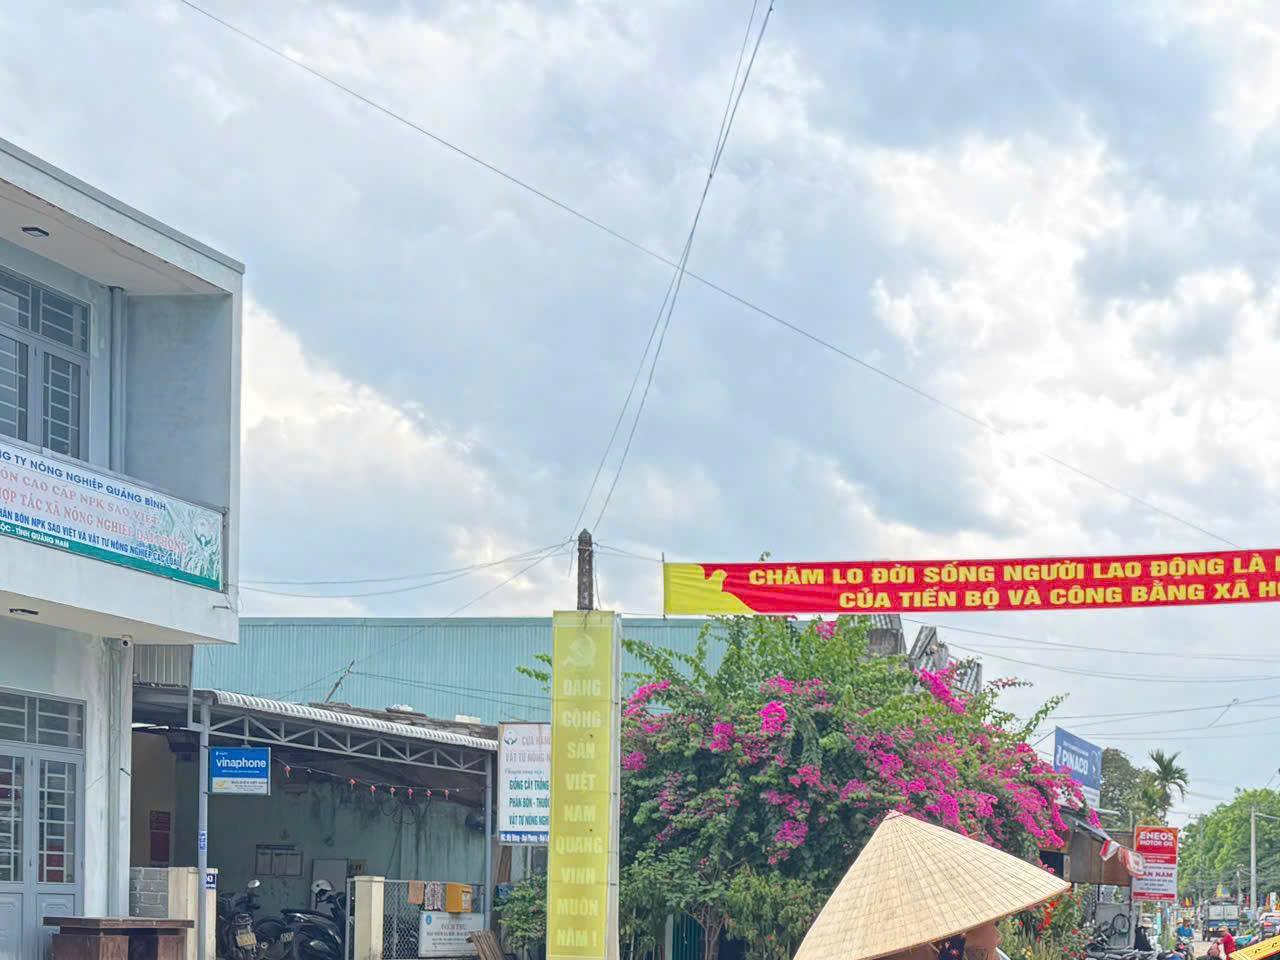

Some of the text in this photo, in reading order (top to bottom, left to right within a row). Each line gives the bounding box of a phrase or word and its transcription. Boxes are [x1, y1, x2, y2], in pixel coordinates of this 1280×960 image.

[14, 454, 27, 466] TY
[30, 461, 63, 478] NÔNG
[66, 471, 103, 491] NGHIỆP
[106, 485, 142, 503] QUẢNG
[144, 496, 167, 511] BÌNH
[23, 476, 49, 492] CAO
[80, 494, 104, 510] NPK
[20, 492, 43, 511] TÁC
[64, 505, 94, 526] NÔNG
[31, 517, 46, 530] NPK
[48, 521, 60, 534] SAO
[111, 539, 129, 553] NÔNG
[749, 566, 824, 585] CHĂM
[832, 568, 864, 584] LO
[871, 563, 915, 584] ĐỜI
[923, 561, 995, 583] SỐNG
[1003, 561, 1085, 582] NGƯỜI
[1093, 561, 1142, 579] LAO
[1150, 556, 1225, 580] ĐỘNG
[1233, 553, 1267, 574] LÀ
[839, 586, 892, 608] CỦA
[900, 586, 957, 608] TIẾN
[965, 587, 1000, 610] BỘ
[1007, 585, 1042, 606] VÀ
[1049, 585, 1123, 605] CÔNG
[1131, 579, 1205, 602] BẰNG
[1213, 578, 1251, 599] XÃ
[216, 757, 267, 769] vinaphone
[1062, 748, 1089, 776] PINACO
[565, 770, 597, 791] VIỆT
[564, 804, 596, 822] NAM
[555, 835, 603, 855] QUANG
[1140, 831, 1174, 841] ENEOS
[560, 867, 596, 885] VINH
[557, 896, 599, 916] MUÔN
